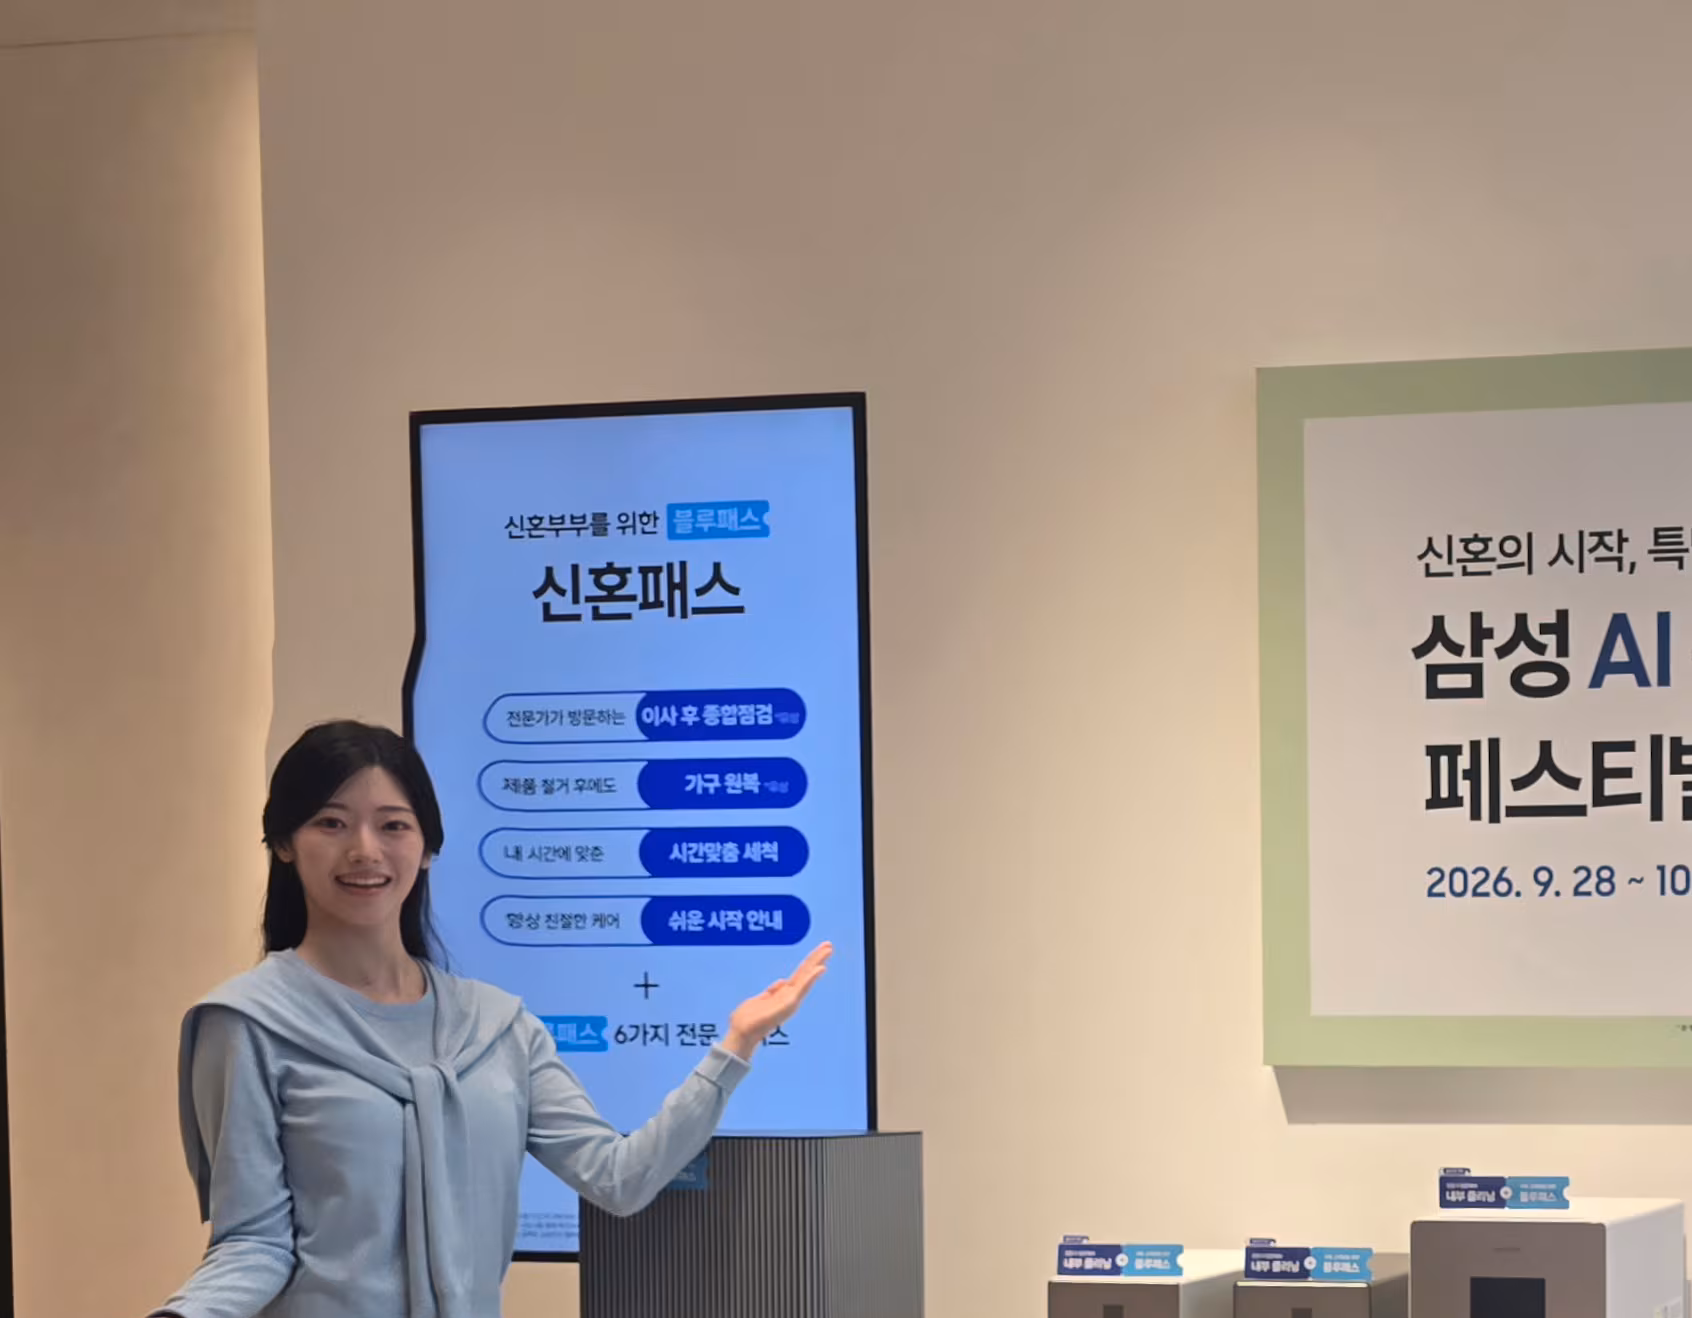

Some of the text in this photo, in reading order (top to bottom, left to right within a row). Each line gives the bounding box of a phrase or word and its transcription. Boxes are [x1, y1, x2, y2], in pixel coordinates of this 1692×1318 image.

[504, 507, 762, 540] 신혼부부를 위한 블루패스
[1416, 531, 1534, 578] 신혼의
[1547, 528, 1637, 576] 시작,
[532, 560, 746, 623] 신혼패스
[1411, 608, 1571, 700] 삼성
[1587, 610, 1671, 689] AI
[506, 709, 565, 728] 전문가가
[567, 707, 626, 727] 방문하는
[641, 704, 679, 727] 이사
[680, 704, 700, 726] 후
[701, 703, 774, 727] 종합점검
[502, 778, 537, 796] 제품
[574, 777, 618, 794] 후에도
[684, 773, 722, 795] 가구
[723, 773, 762, 795] 원복
[504, 841, 779, 864] 내 시간에 맞춘 시간맞춤 세척
[1426, 865, 1522, 898] 2026.
[1532, 865, 1562, 898] 9.
[1572, 865, 1616, 897] 28
[507, 909, 784, 932] 항상 친절한 케어 쉬운 시작 안내
[613, 1022, 671, 1047] 6가지
[676, 1022, 719, 1047] 전문
